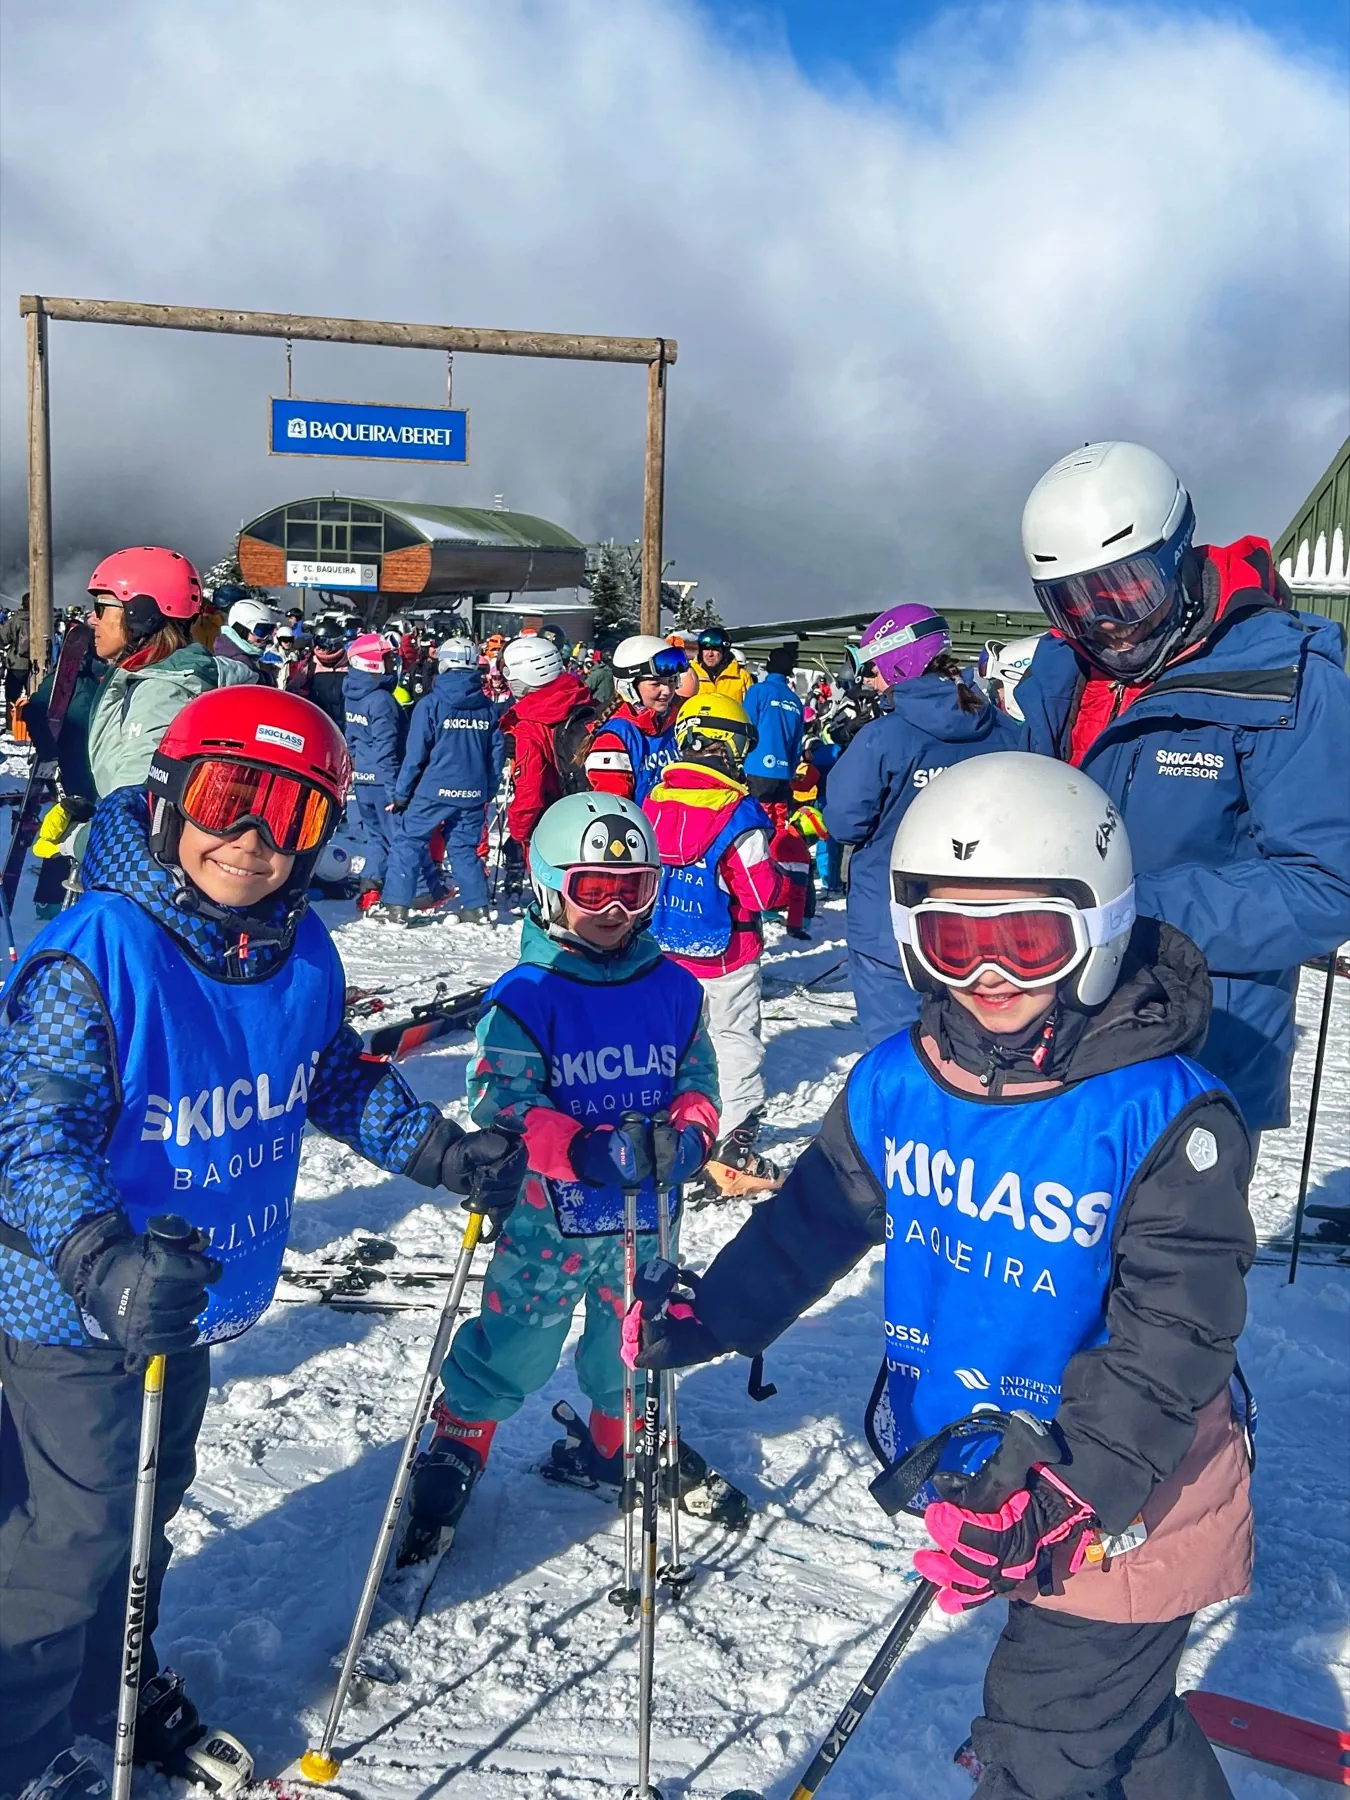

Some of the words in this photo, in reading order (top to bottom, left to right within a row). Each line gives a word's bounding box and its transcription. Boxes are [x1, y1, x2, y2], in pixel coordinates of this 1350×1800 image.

[309, 421, 453, 446] BAQUEIRA/BERET
[316, 565, 357, 574] BAQUEIRA
[443, 718, 490, 731] SKICLASS
[258, 727, 303, 746] SKICLASS
[1155, 749, 1225, 769] SKICLASS
[1157, 765, 1219, 780] PROFESOR
[438, 788, 482, 798] PROFESOR
[885, 1212, 1057, 1298] BAQUEIRA
[117, 1286, 131, 1317] WEDZE
